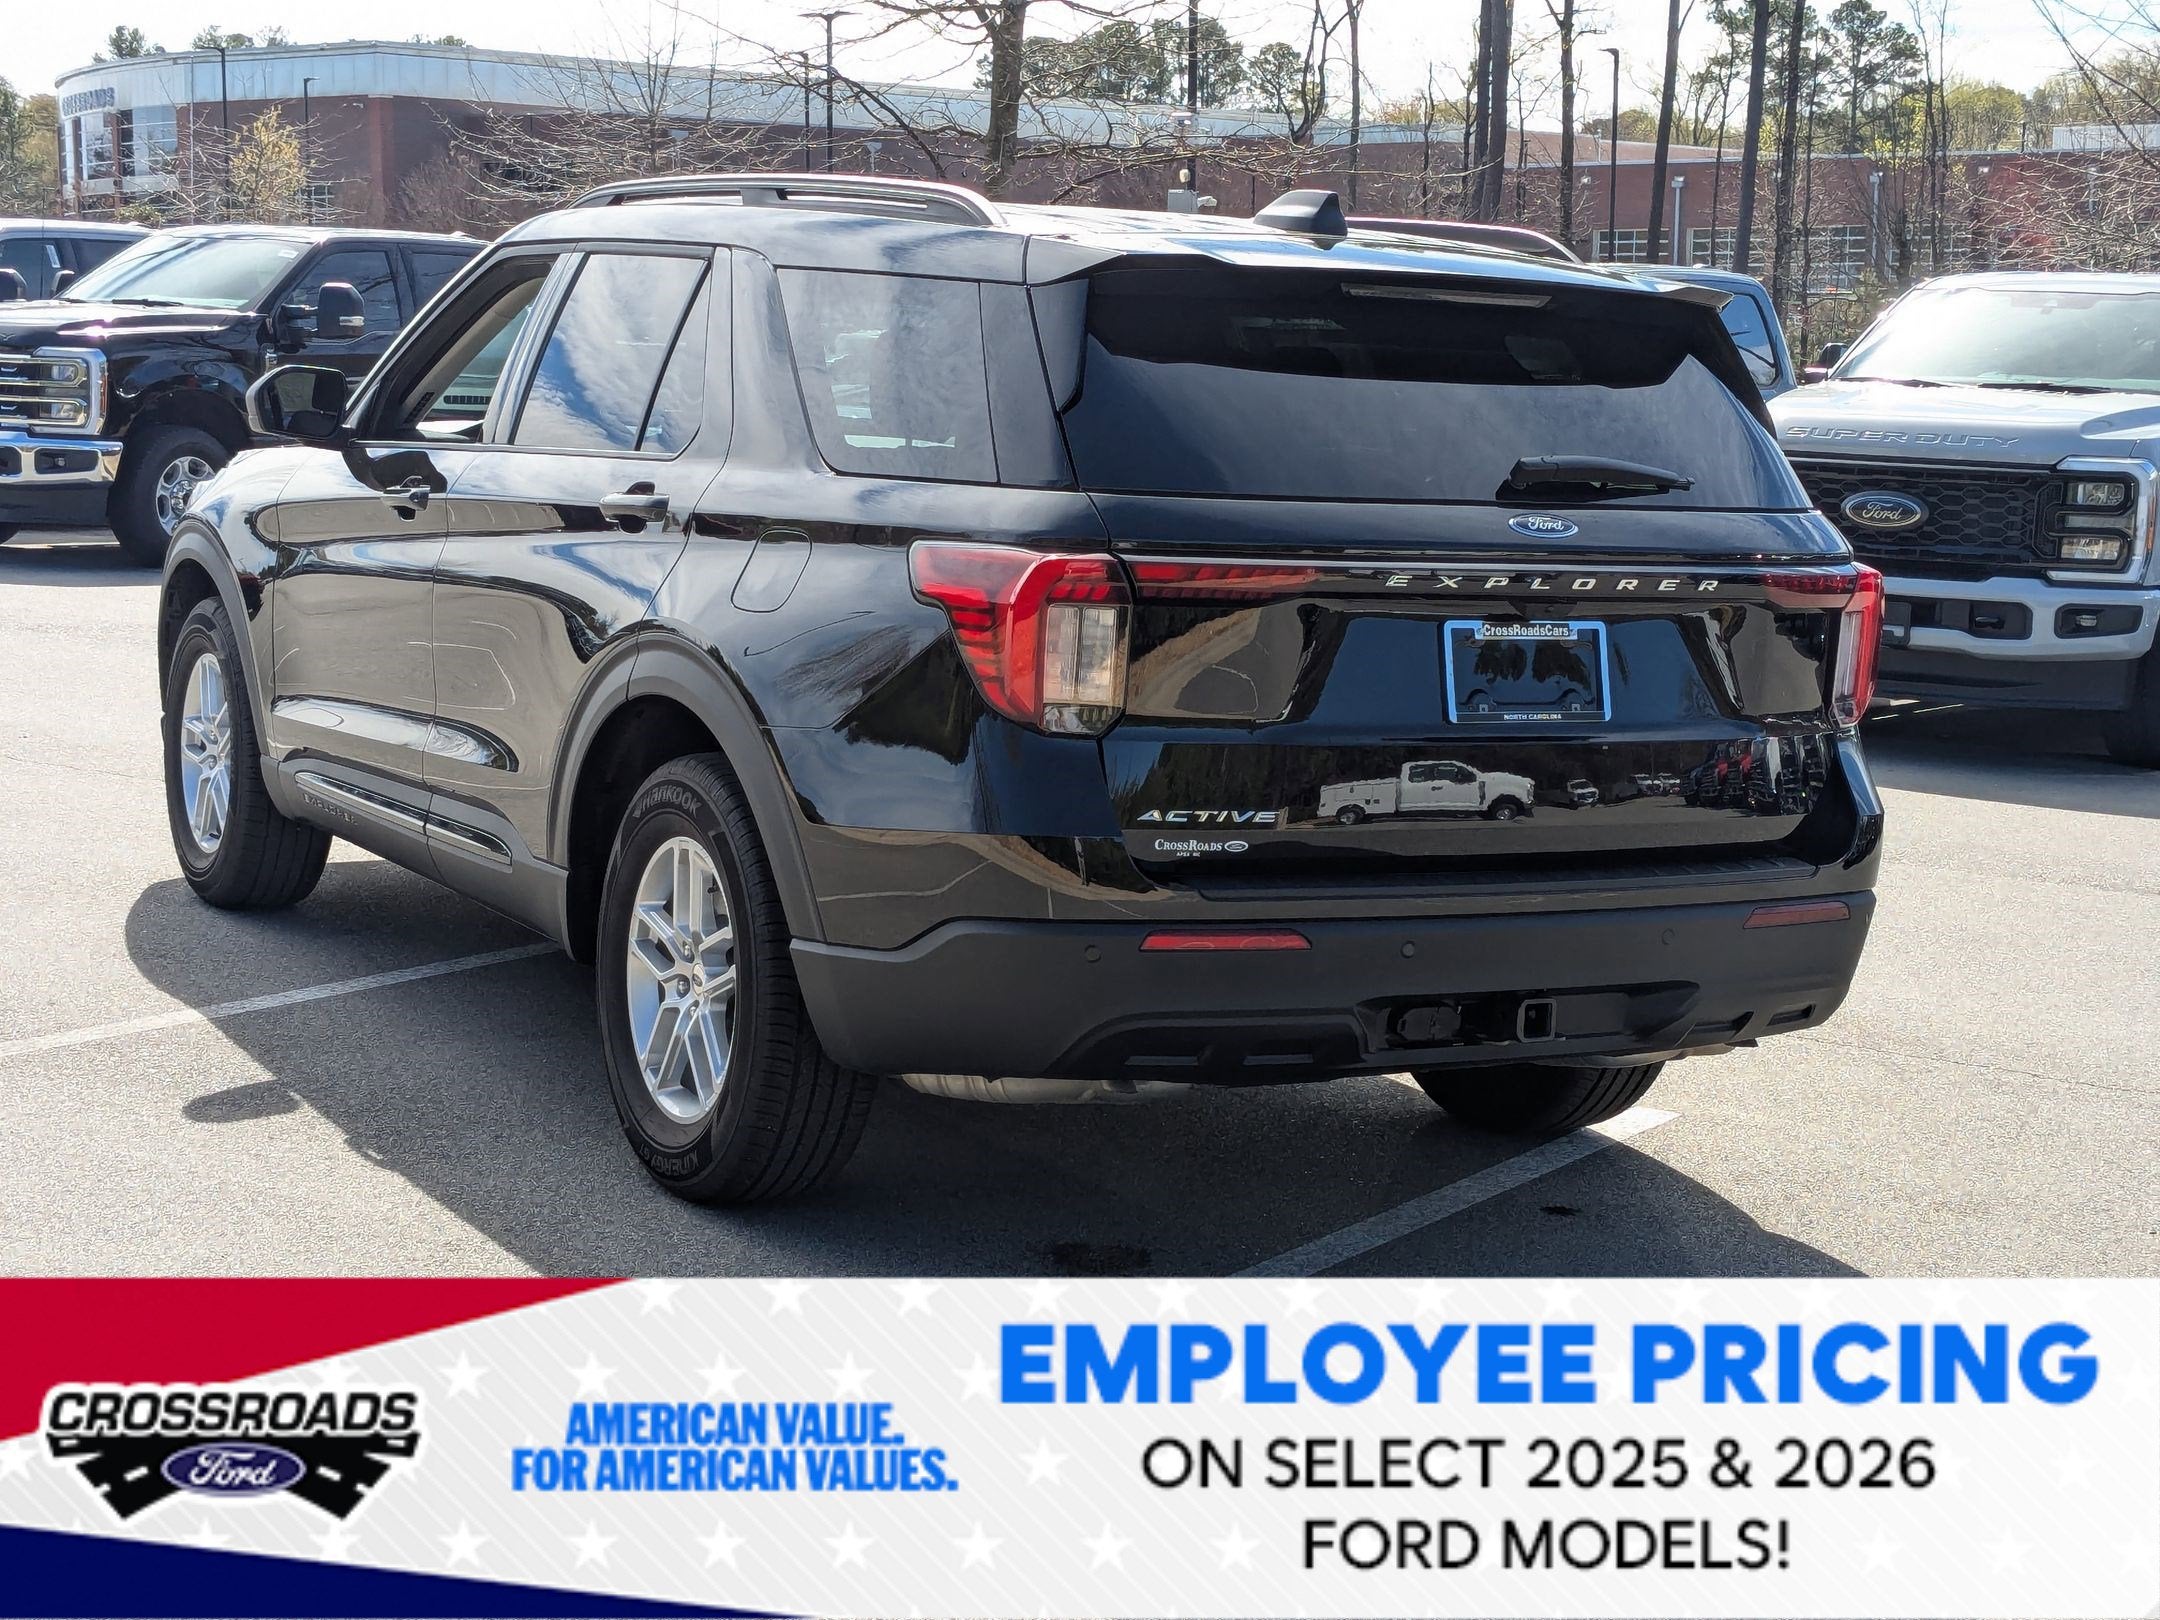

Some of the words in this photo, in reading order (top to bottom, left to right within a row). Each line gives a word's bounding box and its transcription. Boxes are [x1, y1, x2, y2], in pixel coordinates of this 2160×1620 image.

[1785, 425, 1909, 443] SUPER
[1914, 433, 2021, 449] DUTY
[1862, 501, 1904, 520] Ford
[1527, 515, 1565, 532] Ford
[1384, 574, 1720, 593] EXPLORER
[1483, 623, 1570, 637] CrossRoadsCars
[1503, 713, 1528, 721] NORTH
[1528, 712, 1562, 720] CAROLINA
[1136, 809, 1281, 824] ACTIVE
